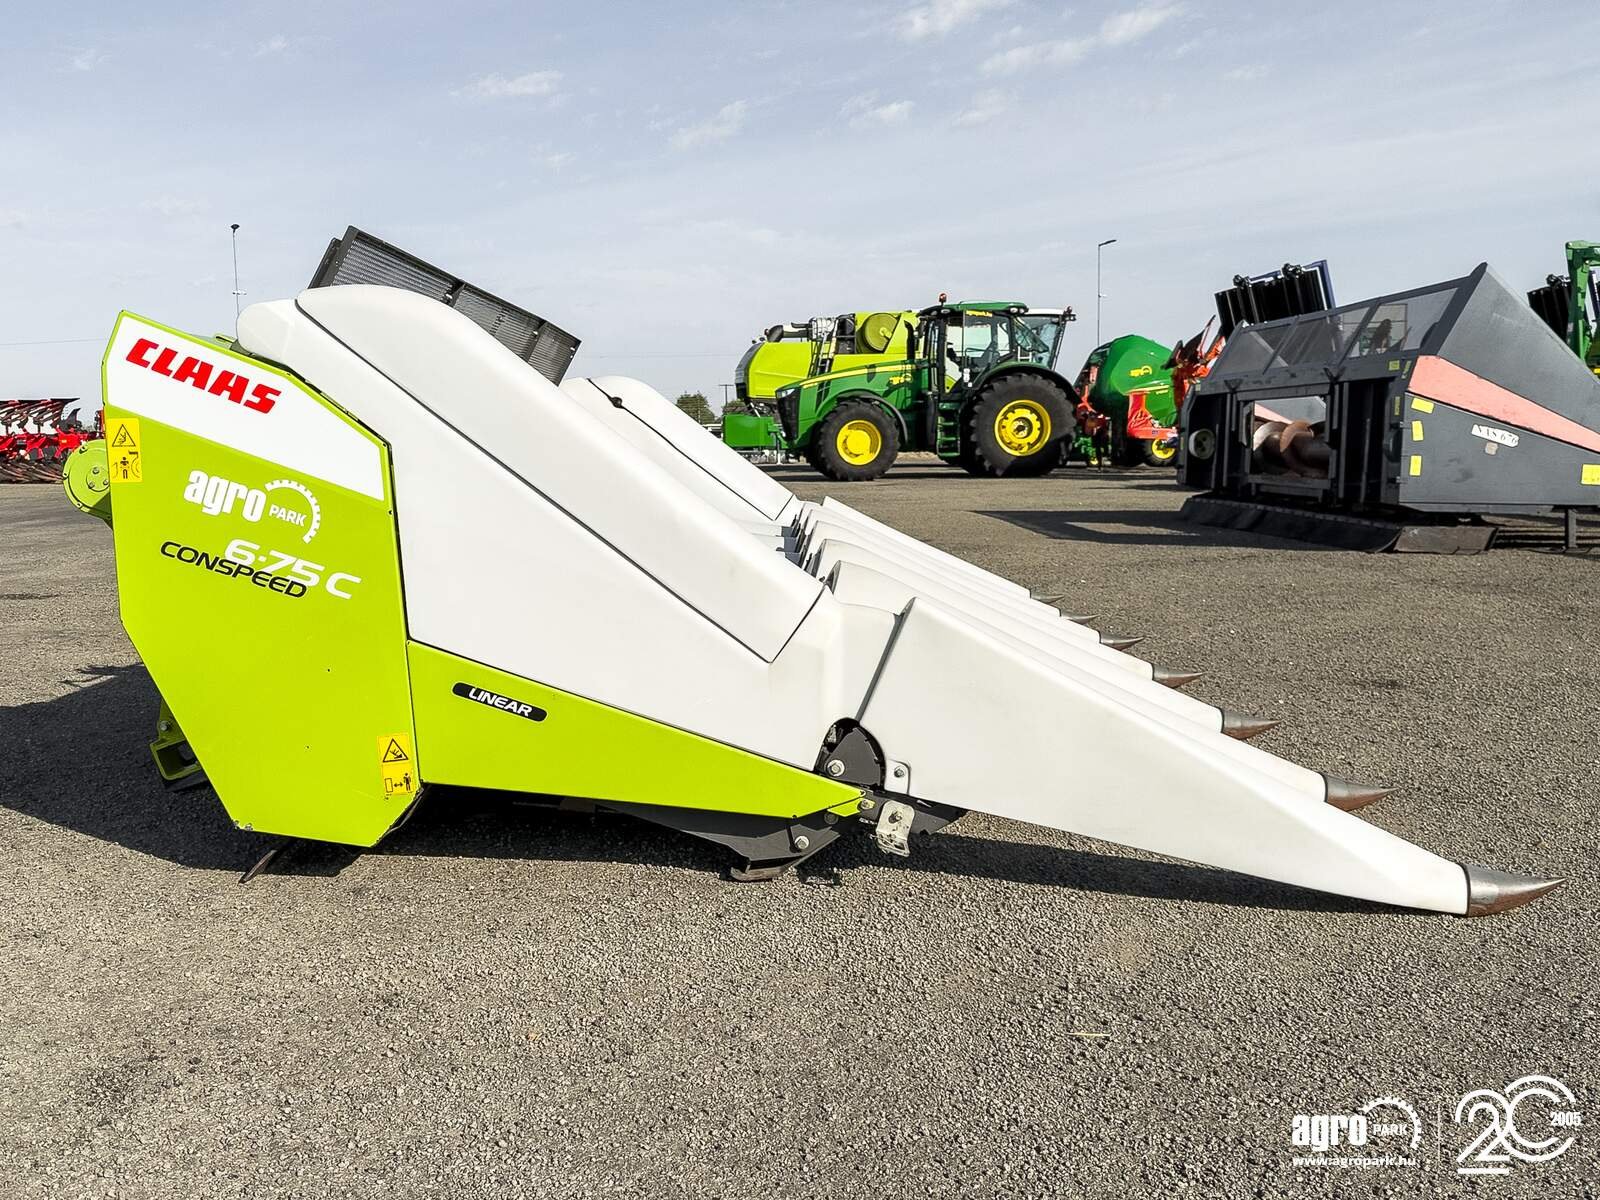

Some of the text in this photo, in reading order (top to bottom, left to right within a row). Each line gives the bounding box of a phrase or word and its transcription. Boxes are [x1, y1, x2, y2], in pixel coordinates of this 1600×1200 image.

[126, 338, 282, 414] CLAAS
[183, 470, 307, 527] agro PARK
[160, 541, 307, 598] CONSPEED
[468, 687, 533, 717] LINEAR
